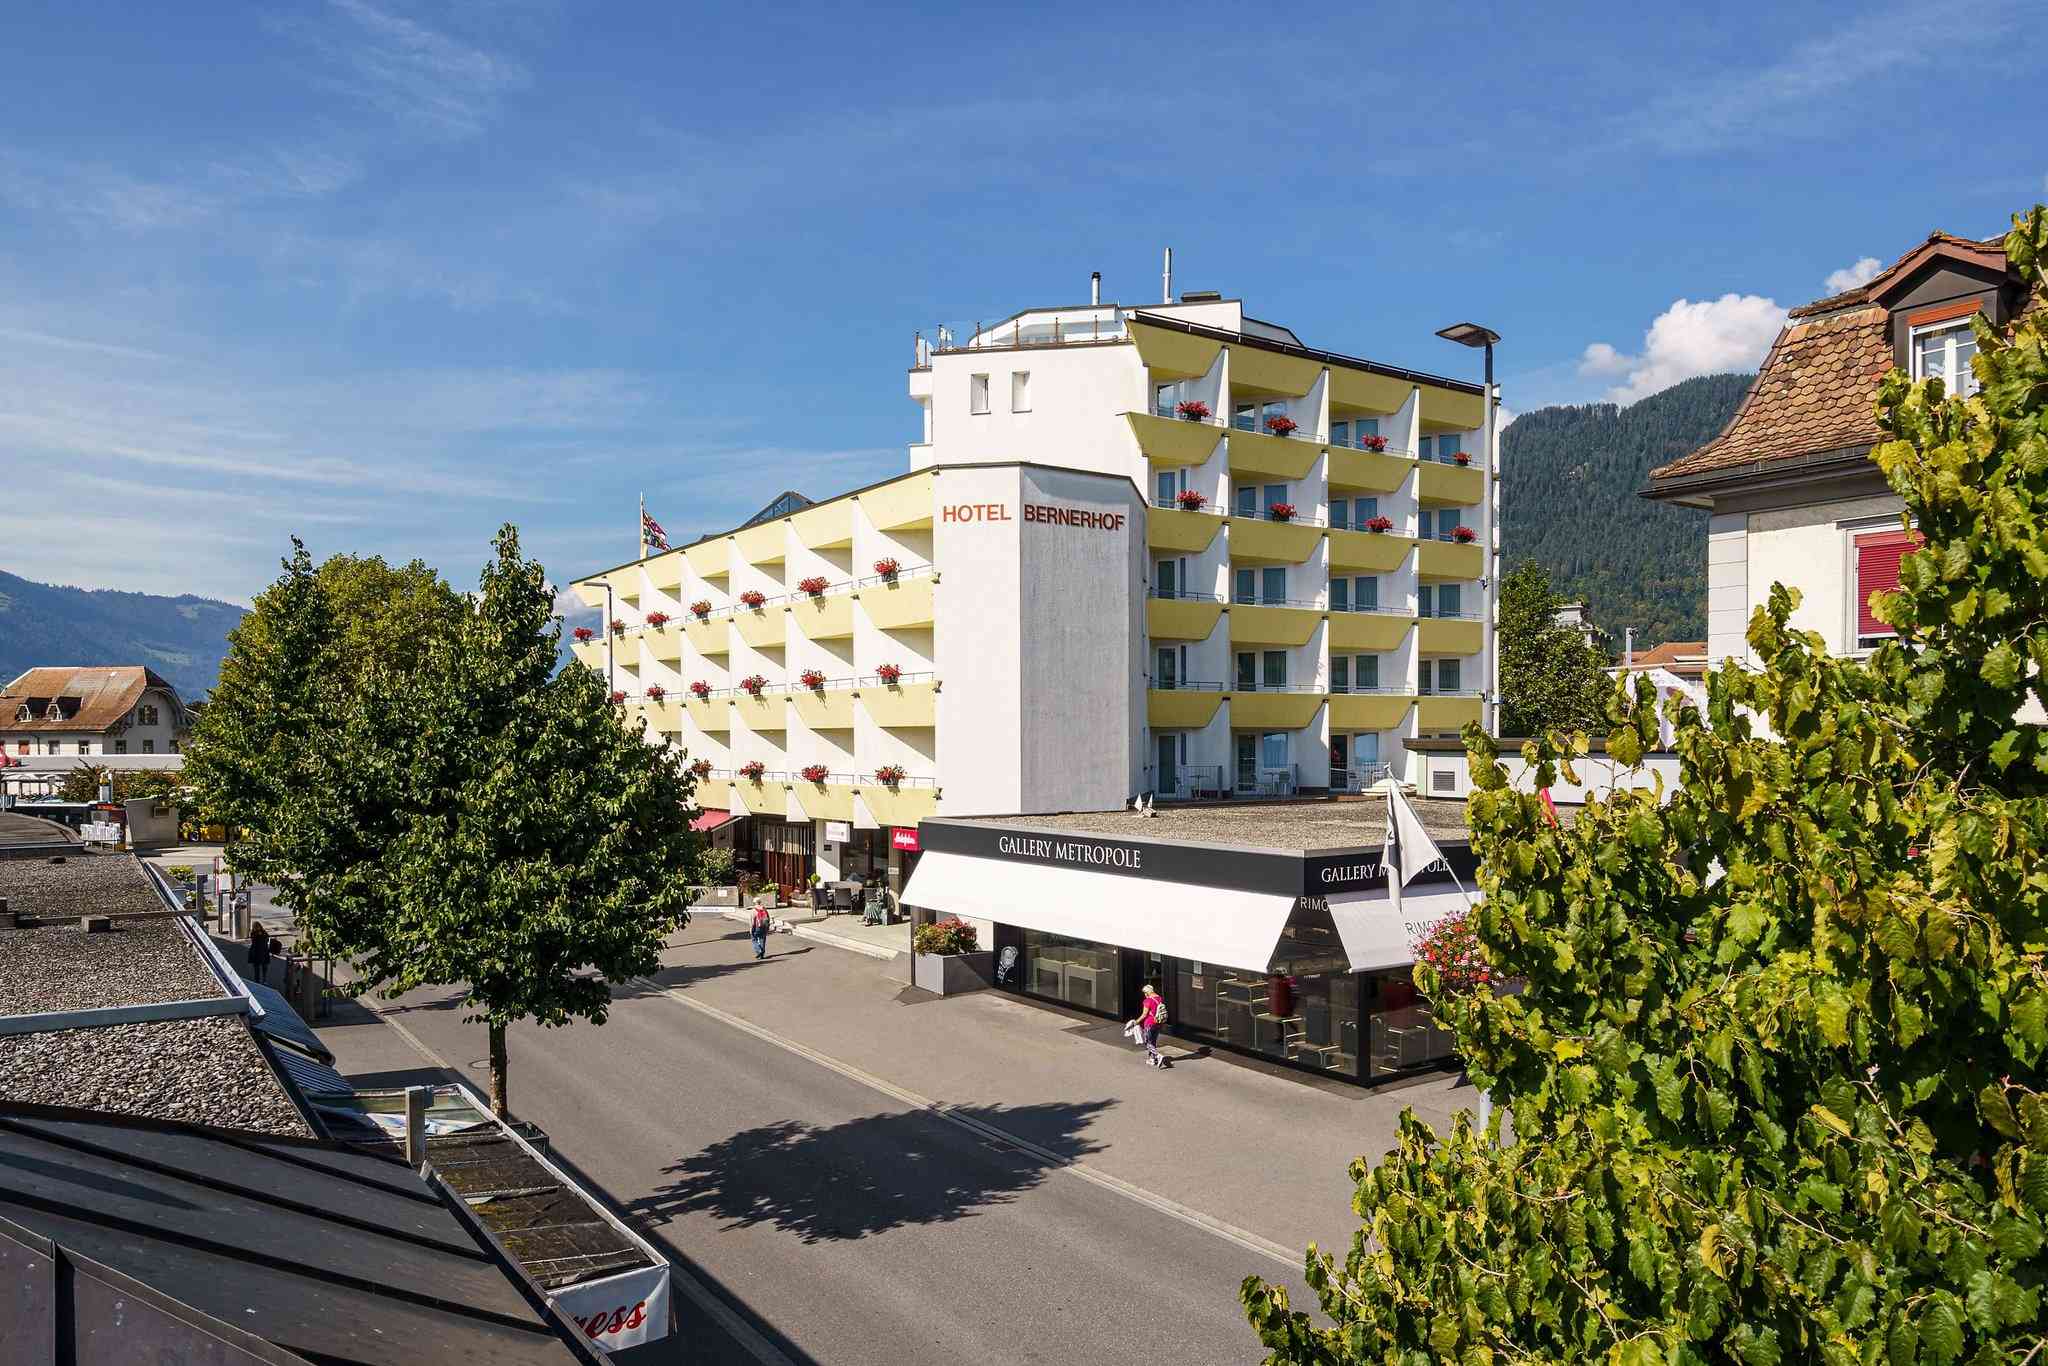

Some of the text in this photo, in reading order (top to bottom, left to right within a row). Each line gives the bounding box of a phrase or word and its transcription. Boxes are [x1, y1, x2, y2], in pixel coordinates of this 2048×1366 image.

[943, 504, 1124, 531] HOTEL BERNERHOF
[999, 836, 1141, 868] GALLERY METROPOLE
[1321, 863, 1375, 883] GALLERY
